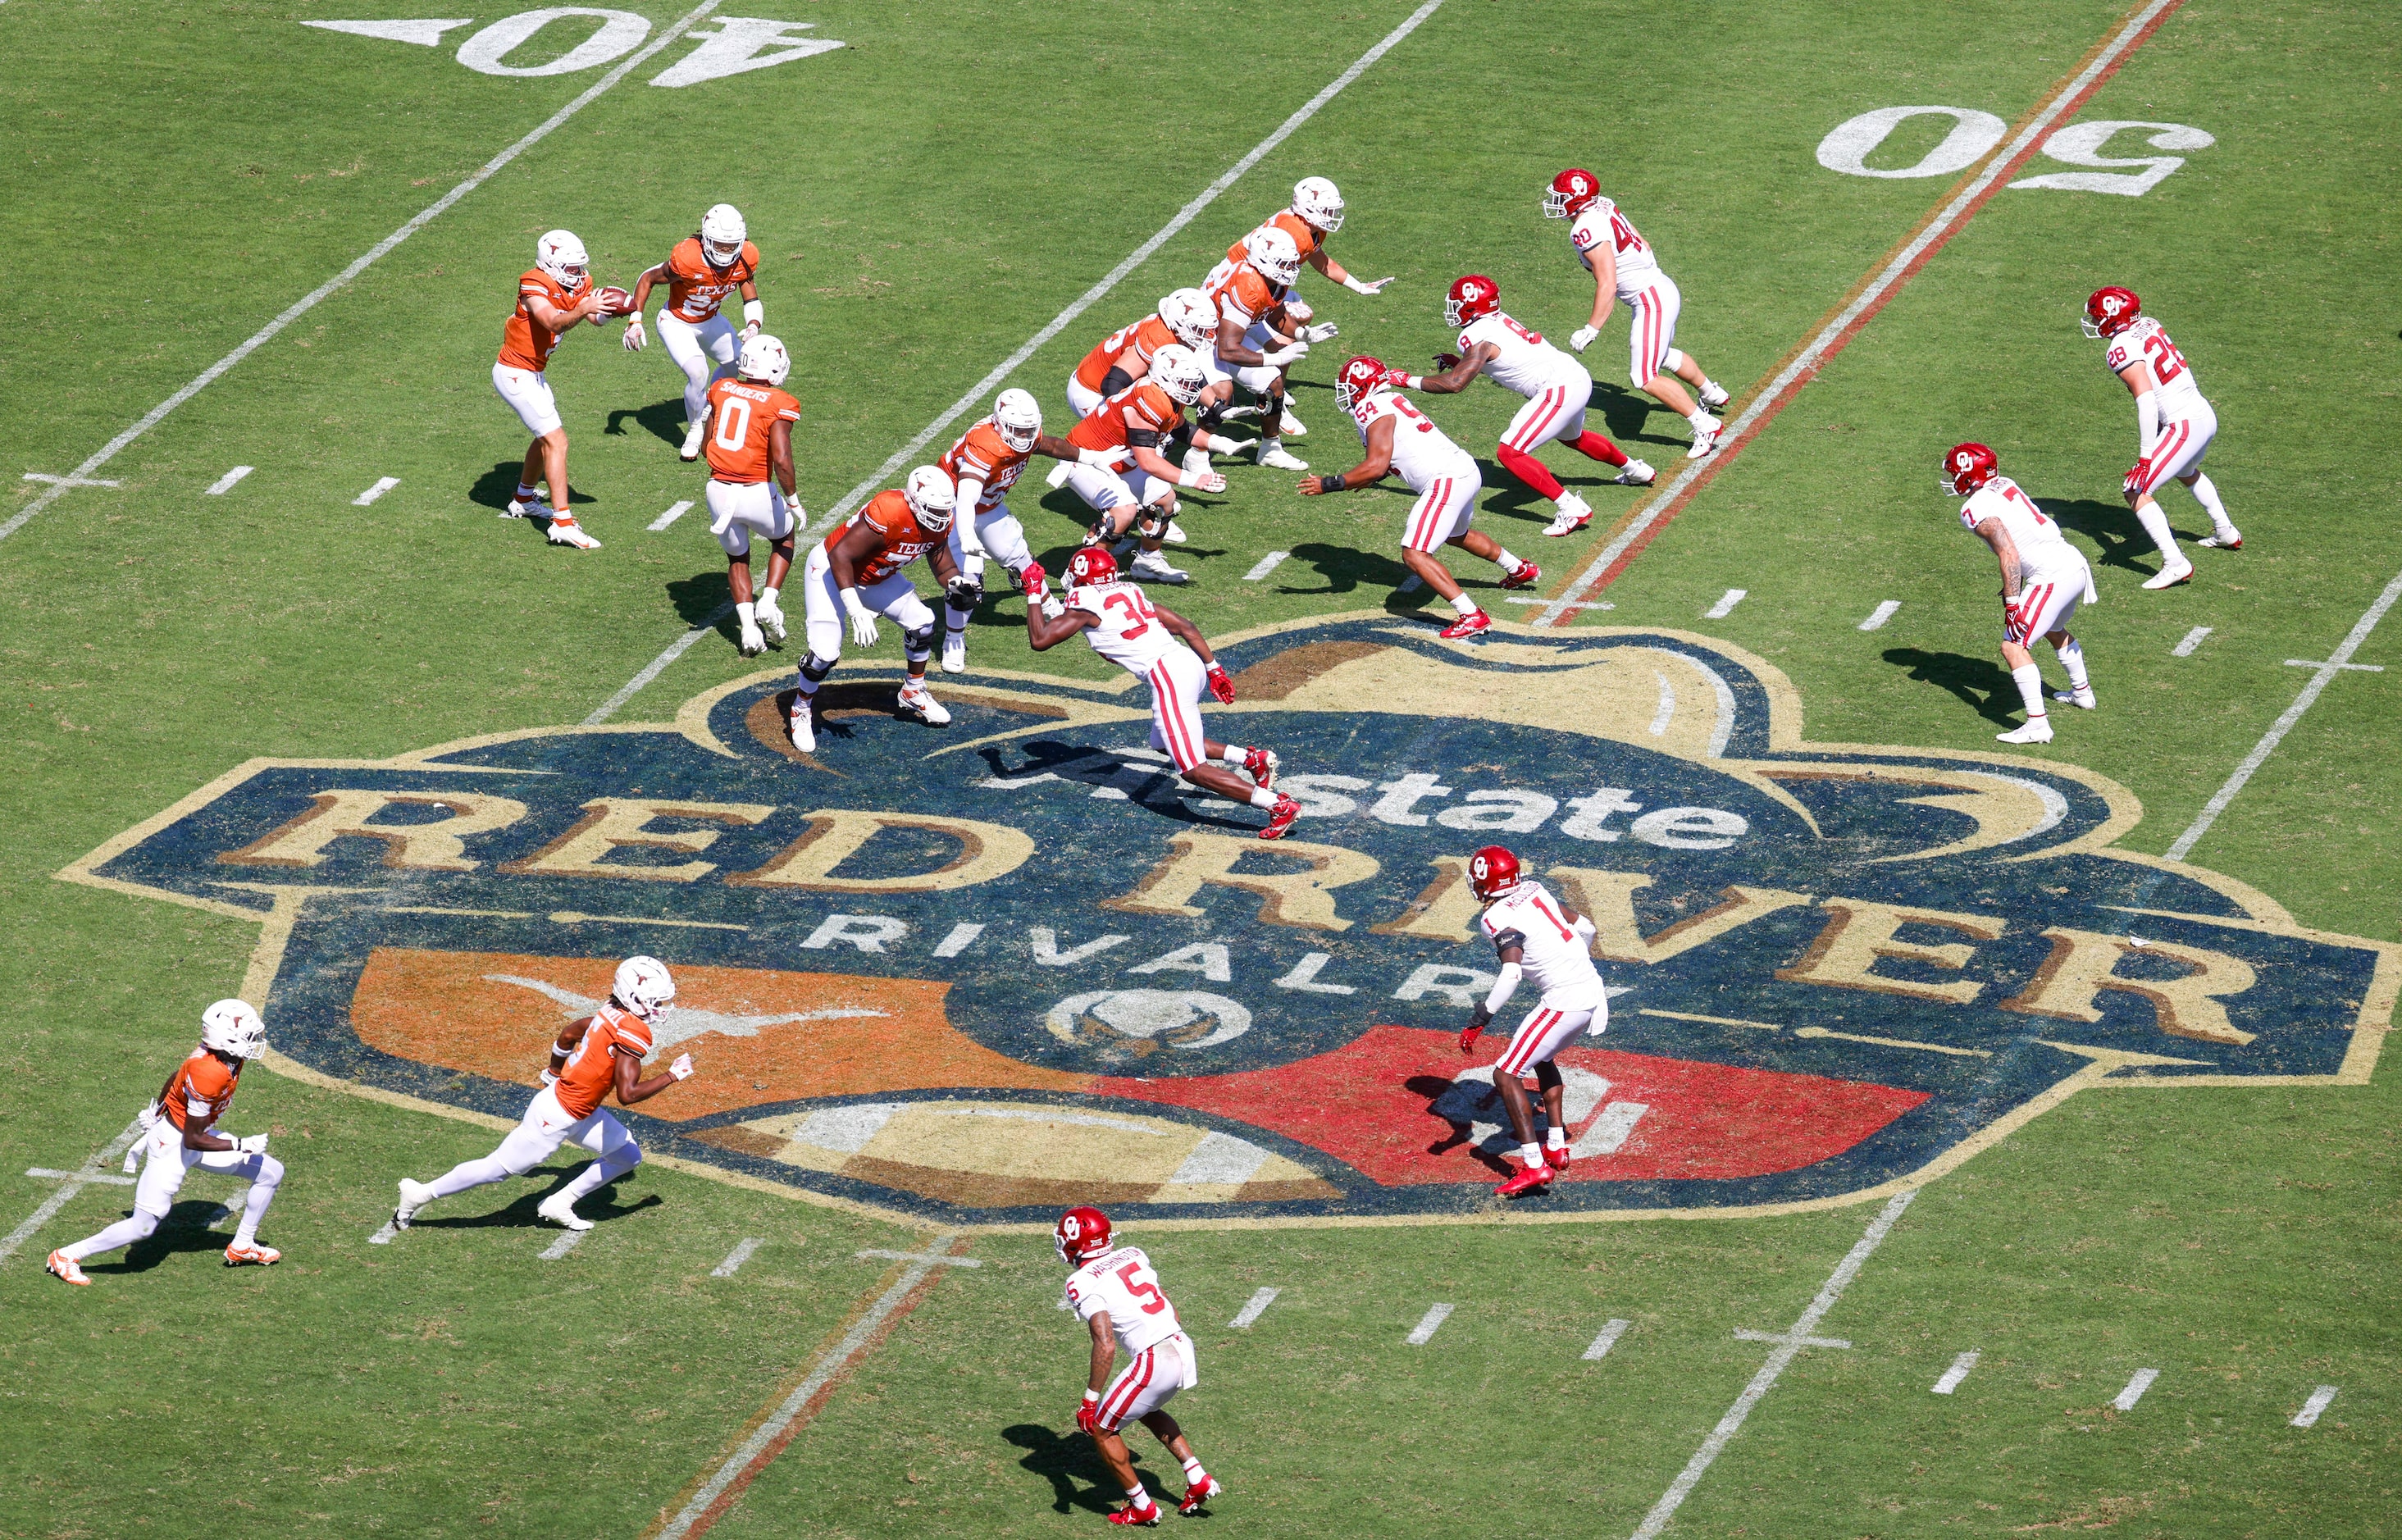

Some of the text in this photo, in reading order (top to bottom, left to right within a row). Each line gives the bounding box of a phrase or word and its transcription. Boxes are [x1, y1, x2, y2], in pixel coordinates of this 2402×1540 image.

[456, 7, 845, 88] 40
[1816, 105, 2215, 197] 50
[696, 281, 737, 296] TEXAS
[2107, 345, 2127, 369] 28
[2144, 326, 2188, 386] 28
[720, 381, 771, 403] SANDERS
[715, 396, 752, 453] 0
[1355, 400, 1379, 424] 54
[1000, 458, 1028, 481] TEXAS
[1962, 508, 1976, 525] 7
[2002, 485, 2047, 526] 7
[897, 542, 934, 554] TEXAS
[1073, 554, 1089, 576] OU
[1103, 590, 1157, 641] 34
[1474, 856, 1488, 880] OU
[216, 789, 2257, 1046] RED RIVER
[1484, 918, 1497, 935] 1
[1531, 895, 1574, 943] 1
[799, 914, 1634, 1009] RIVALR
[1064, 1215, 1081, 1241] OU
[1066, 1280, 1080, 1301] 5
[1115, 1260, 1165, 1315] 5
